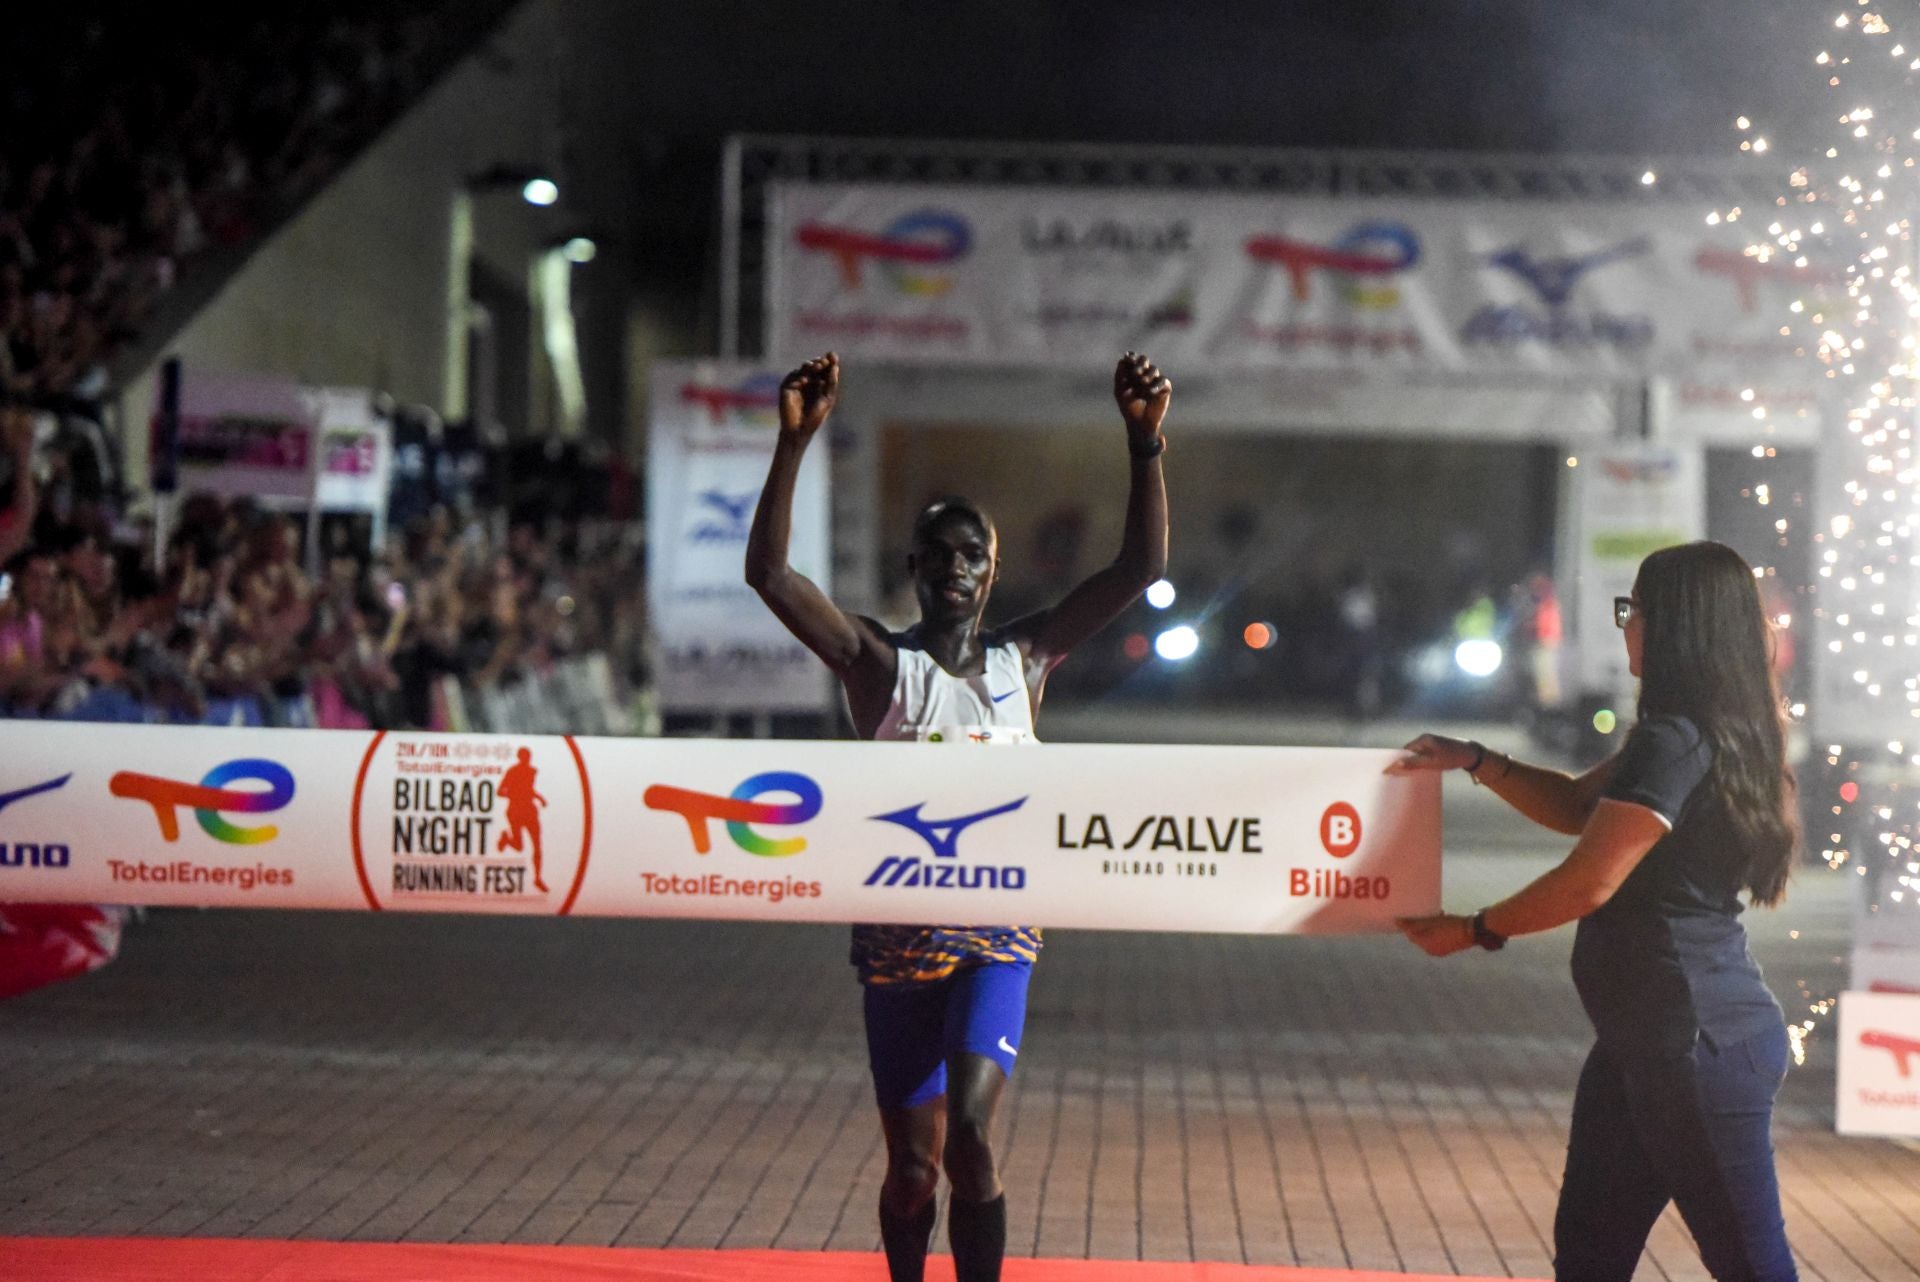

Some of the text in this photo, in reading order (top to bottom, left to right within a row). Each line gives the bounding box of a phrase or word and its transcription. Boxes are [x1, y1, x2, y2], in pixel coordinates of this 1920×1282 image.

[394, 778, 494, 814] BILBAO
[393, 816, 492, 856] NIGHT
[1057, 813, 1263, 854] LA SALVE
[107, 860, 294, 890] TotalEnergies
[393, 864, 526, 895] RUNNING FEST
[863, 856, 1026, 890] MIZUNO
[1102, 860, 1165, 876] BILBAO
[1290, 868, 1390, 900] Bilbao
[641, 872, 822, 902] TotalEnergies
